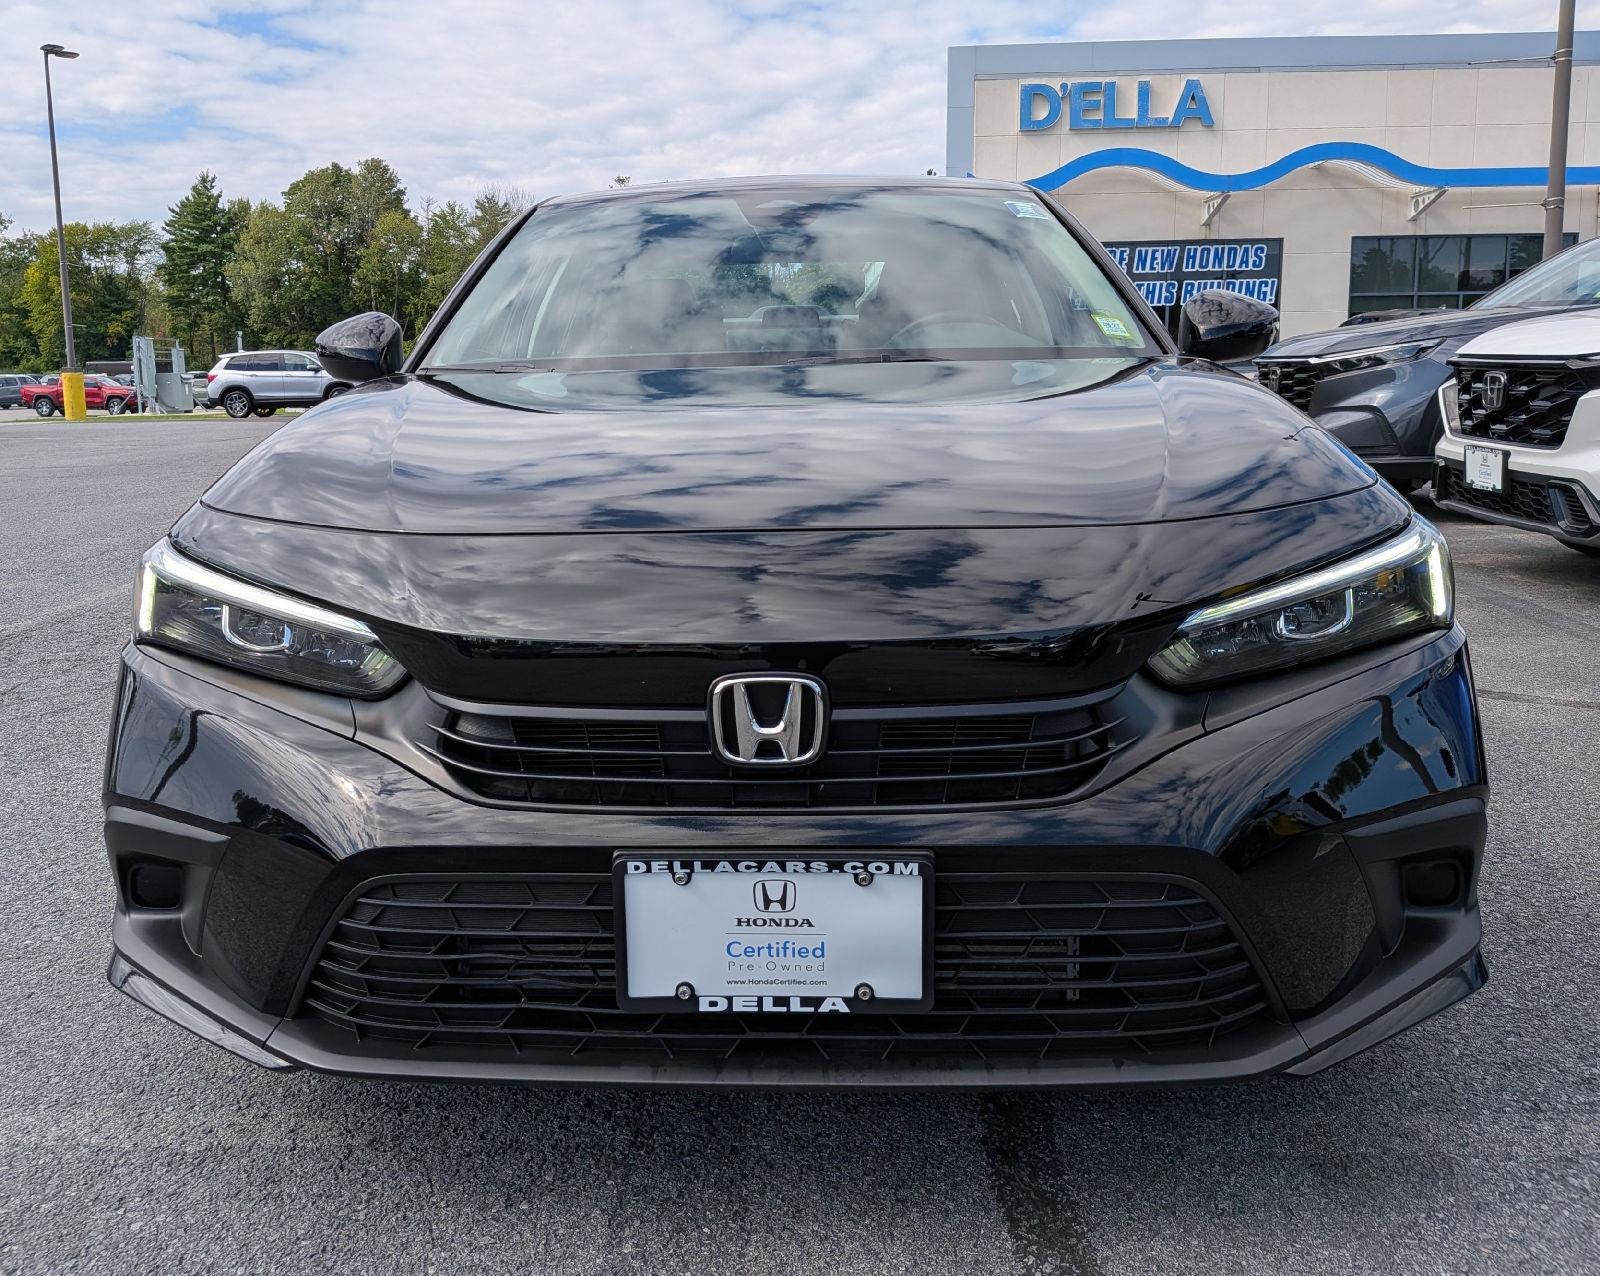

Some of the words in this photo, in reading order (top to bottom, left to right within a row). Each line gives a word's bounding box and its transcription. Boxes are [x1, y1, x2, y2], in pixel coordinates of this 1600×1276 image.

[1019, 78, 1215, 132] D'ELLA
[1133, 246, 1180, 273] NEW
[1182, 244, 1268, 272] HONDAS
[626, 861, 919, 876] DELLACARS.COM
[735, 917, 815, 928] HONDA
[726, 940, 826, 959] Certified
[727, 960, 826, 973] Pre-Owned
[726, 978, 828, 986] www.HondaCertified.com
[698, 996, 850, 1013] DELLA
